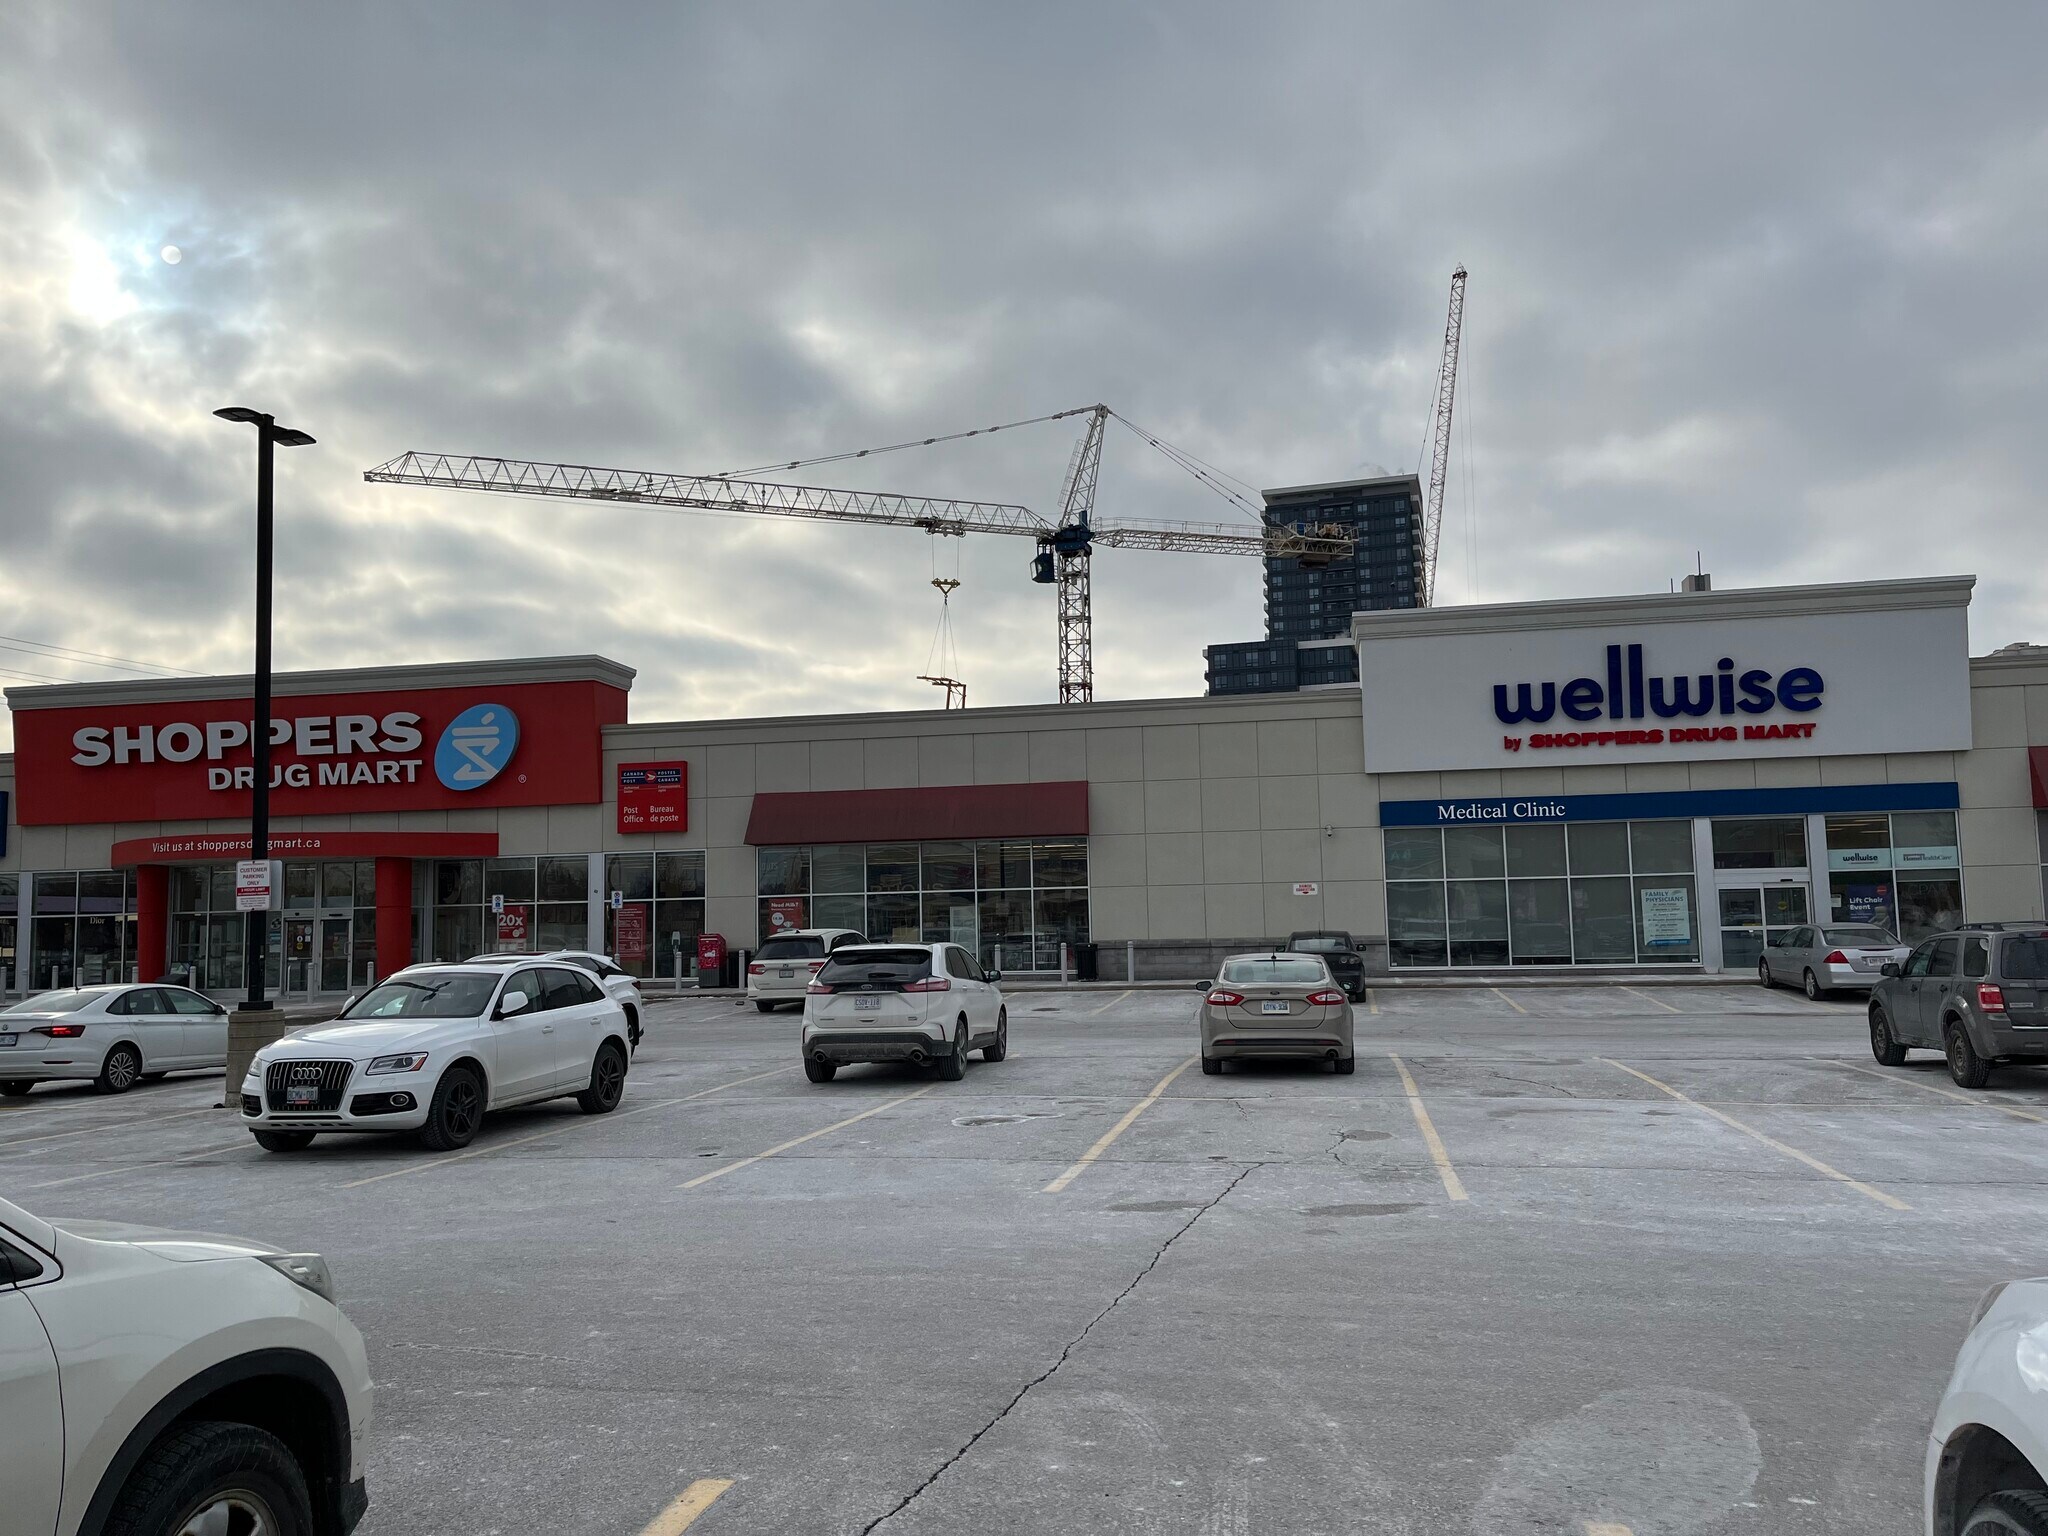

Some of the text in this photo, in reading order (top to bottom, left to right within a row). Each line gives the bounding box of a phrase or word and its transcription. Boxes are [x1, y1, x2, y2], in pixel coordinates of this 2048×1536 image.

[1493, 643, 1825, 725] wellwise
[71, 711, 423, 767] SHOPPERS
[1503, 723, 1817, 752] by SHOPPERS DRUG MART
[318, 759, 423, 786] MART
[623, 805, 674, 814] Post Bureau
[1437, 801, 1566, 820] Medical Clinic
[623, 814, 679, 824] Office de poste
[152, 838, 321, 853] Visit us at shoppersdgmart.ca
[1842, 852, 1879, 862] wellwise
[89, 916, 106, 925] Dior
[499, 914, 524, 927] 20x
